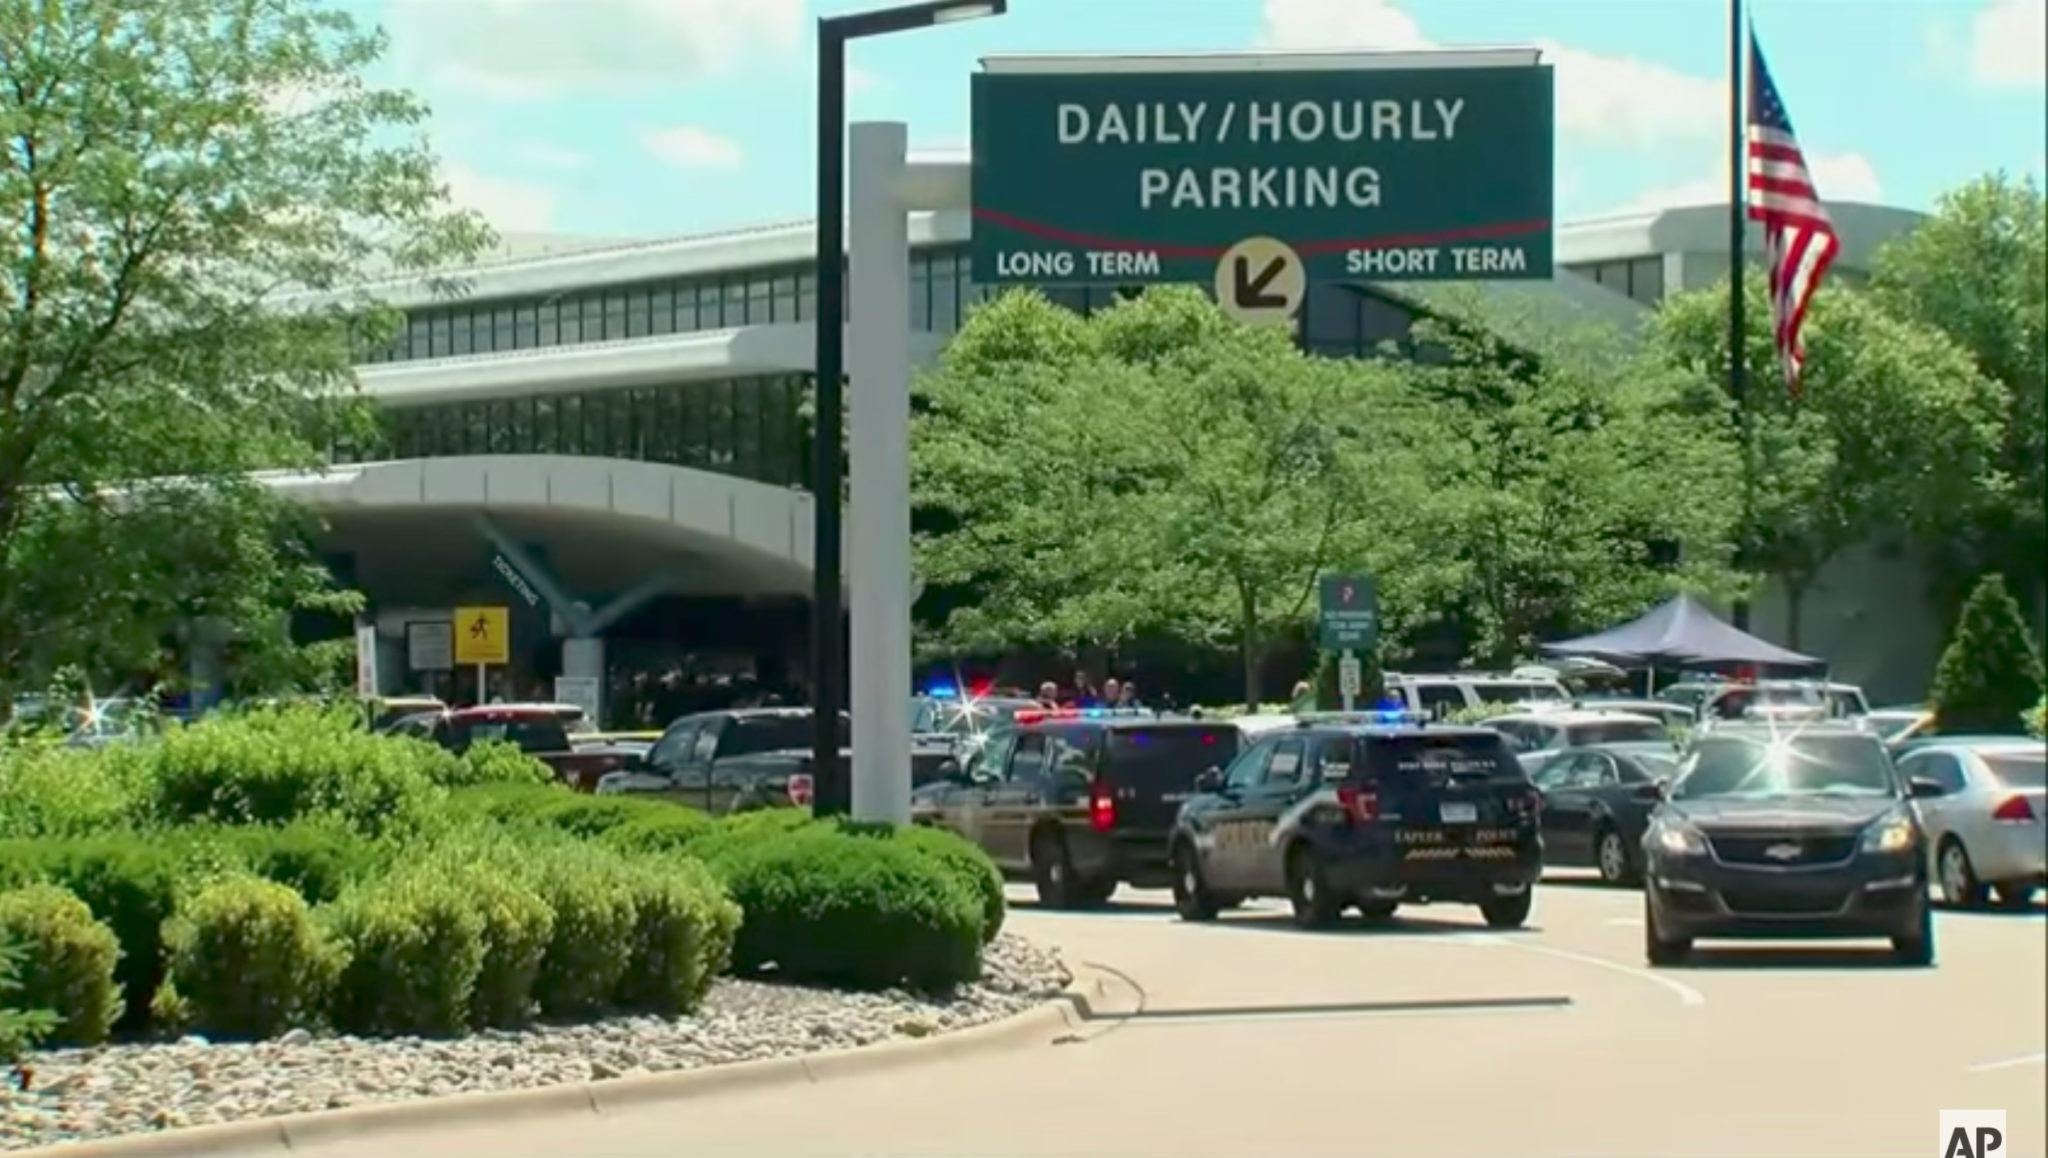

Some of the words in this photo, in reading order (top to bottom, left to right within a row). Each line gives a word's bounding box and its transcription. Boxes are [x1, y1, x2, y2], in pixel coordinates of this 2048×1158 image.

[1140, 167, 1381, 207] PARKING
[997, 251, 1075, 276] LONG
[1086, 250, 1160, 275] TERM
[1346, 247, 1438, 273] SHORT
[1451, 247, 1526, 271] TERM
